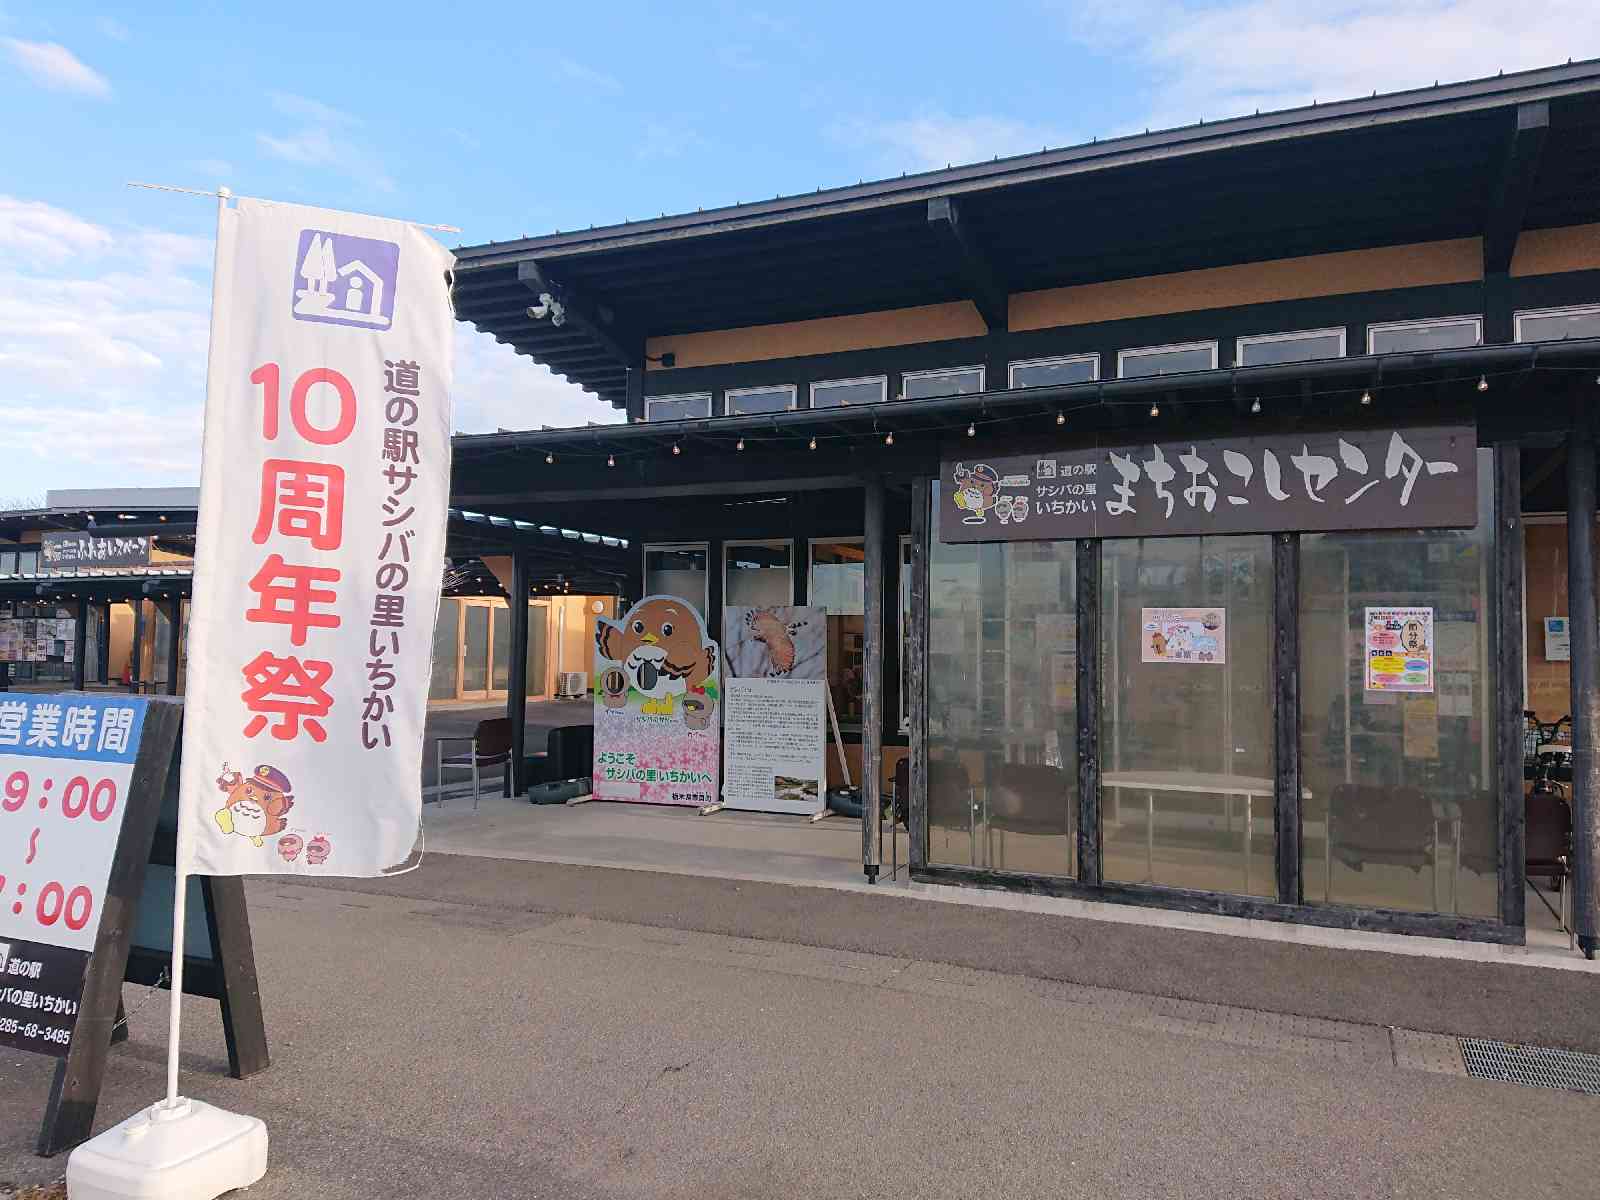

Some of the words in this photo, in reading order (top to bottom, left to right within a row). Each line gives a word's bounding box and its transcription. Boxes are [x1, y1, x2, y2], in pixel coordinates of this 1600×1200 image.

[1060, 463, 1097, 477] 道の駅
[1104, 430, 1460, 519] まちおこしセンター
[1035, 483, 1097, 498] サシバの里
[1035, 499, 1097, 515] いちかい
[241, 361, 358, 743] 10周年祭
[362, 359, 421, 751] 道の駅サシバの里いちかい
[0, 700, 136, 755] 営業時間
[597, 751, 636, 765] ようこそ
[605, 766, 712, 784] サシバの里いちかいへ
[2, 770, 118, 822] 9:00
[7, 957, 43, 979] 道の駅
